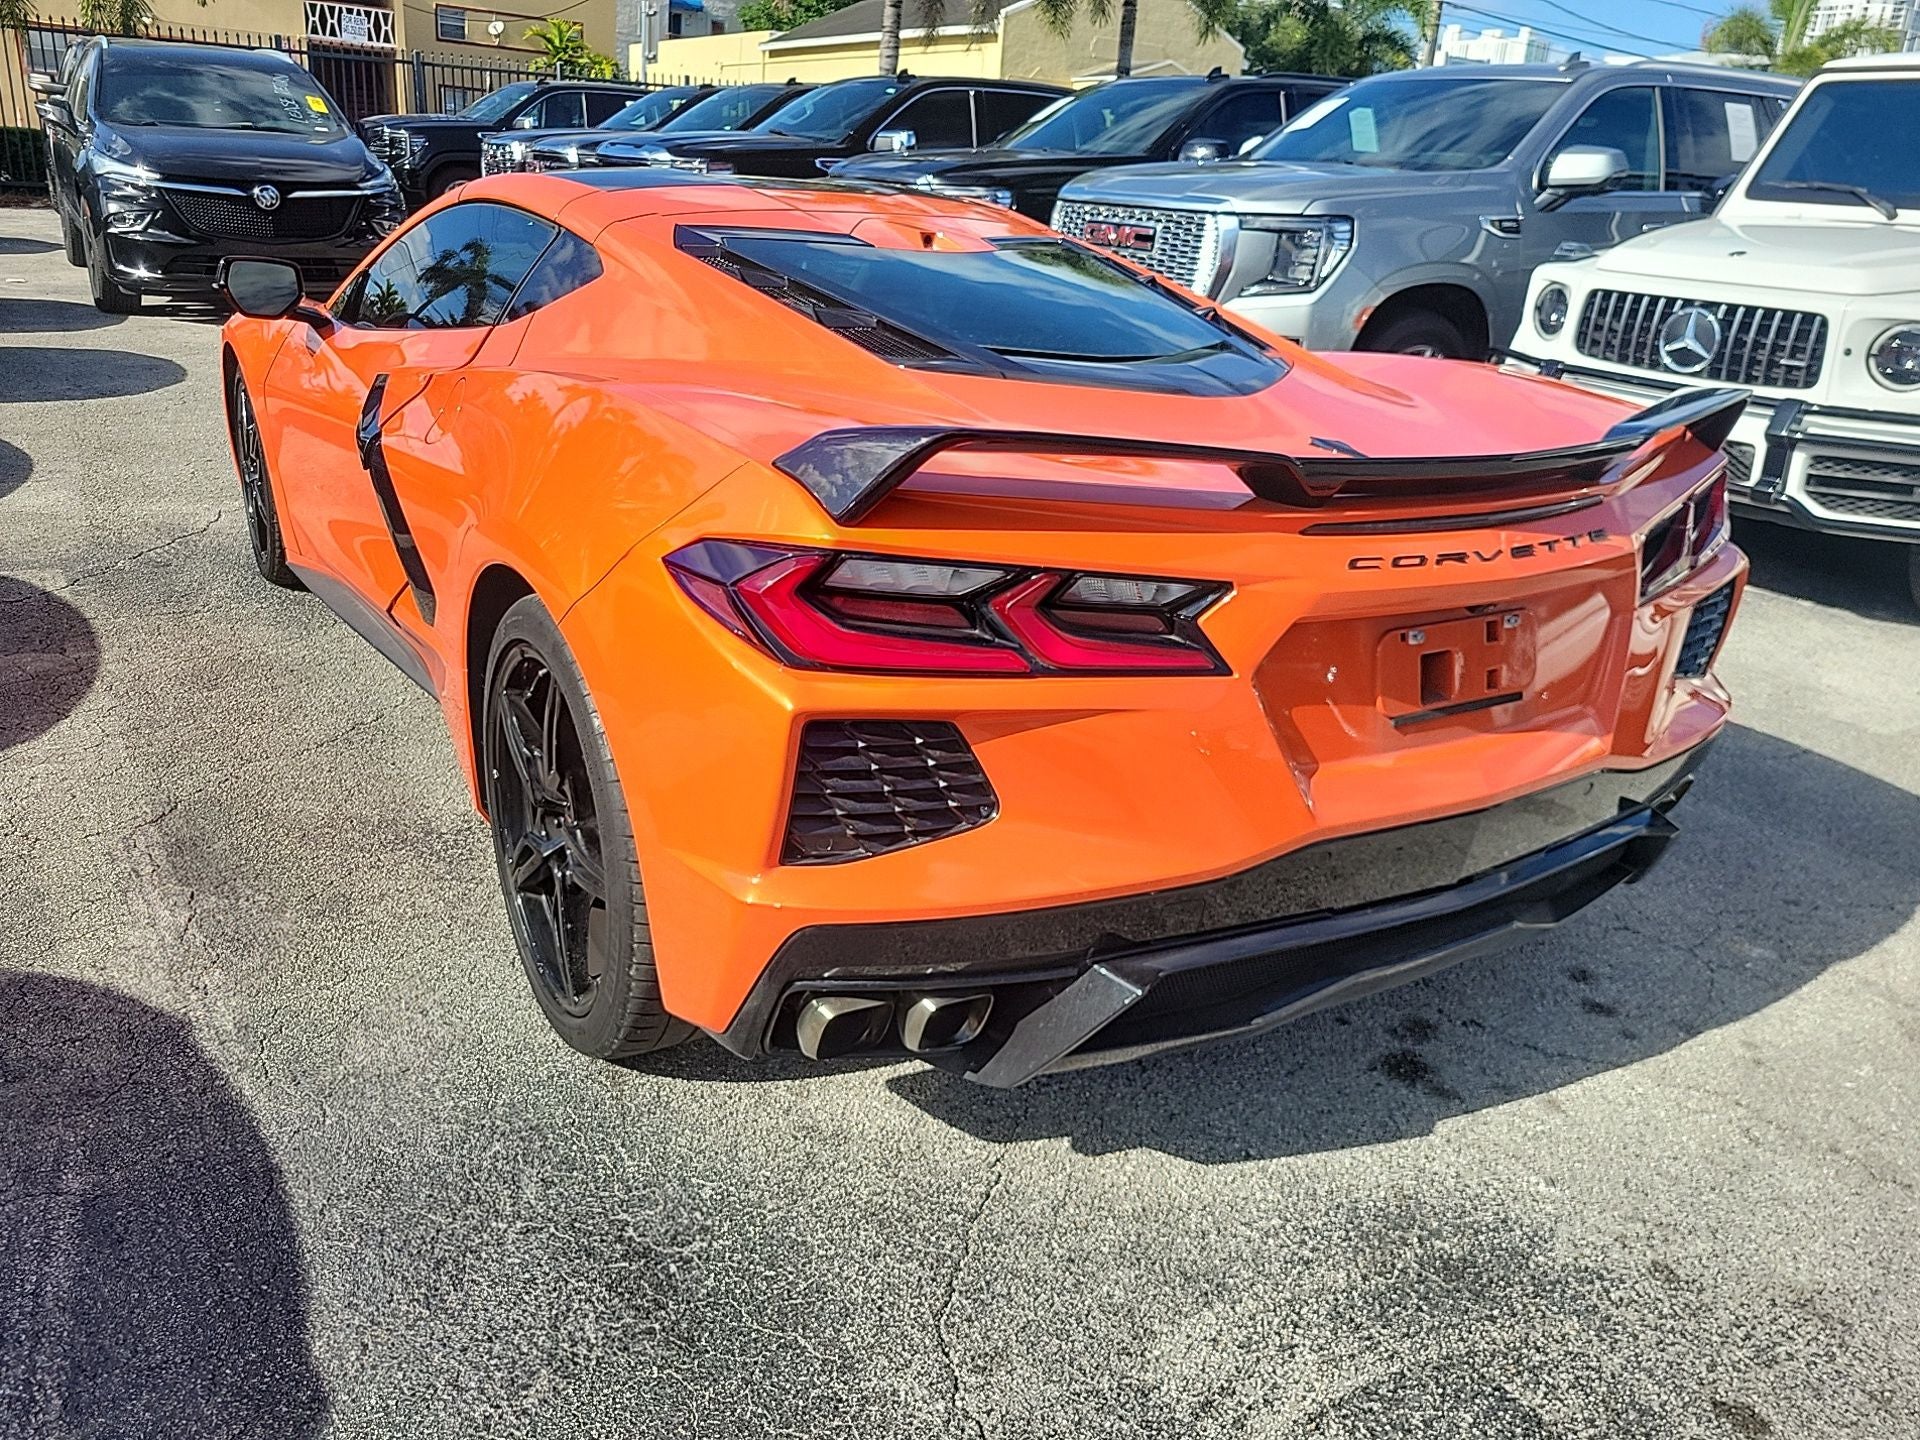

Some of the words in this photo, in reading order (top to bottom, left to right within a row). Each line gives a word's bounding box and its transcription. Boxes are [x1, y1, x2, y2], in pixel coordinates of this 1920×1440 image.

[343, 14, 353, 24] FOR
[353, 16, 366, 26] RENT
[1084, 222, 1154, 250] GMC
[1348, 529, 1609, 570] CORVETTE
